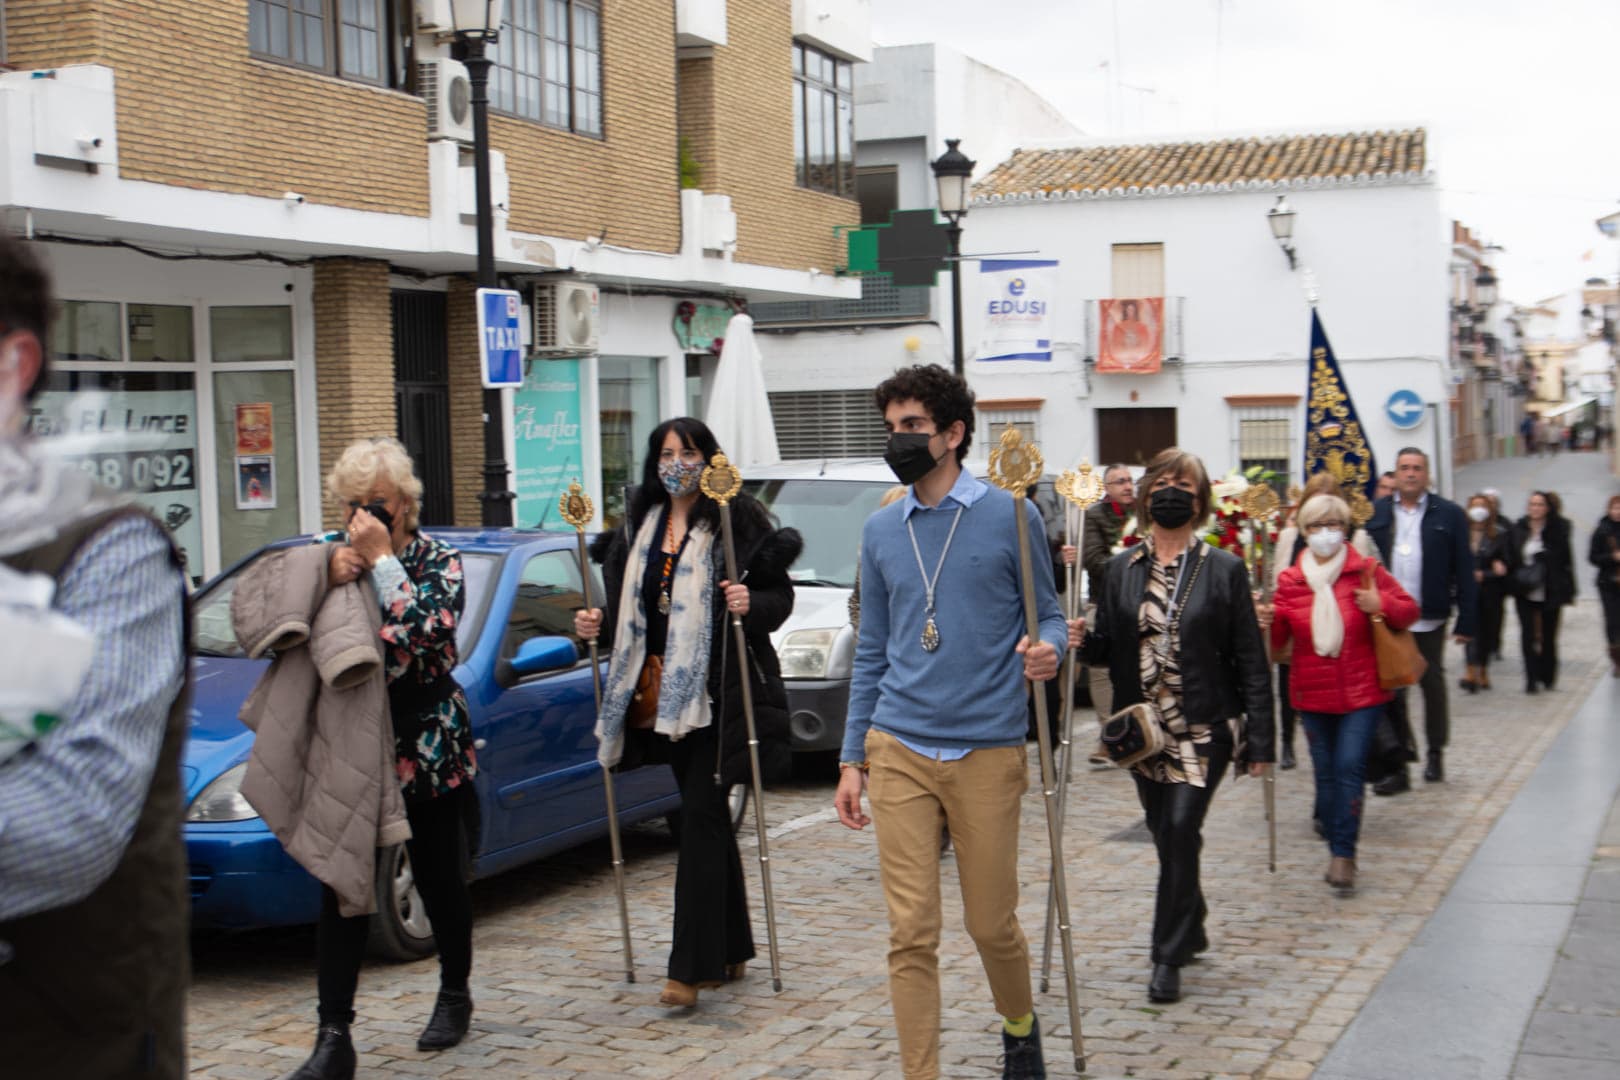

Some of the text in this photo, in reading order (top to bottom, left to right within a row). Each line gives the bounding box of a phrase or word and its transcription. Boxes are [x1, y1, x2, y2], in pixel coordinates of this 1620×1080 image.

[989, 300, 1047, 315] EDUSI
[485, 327, 520, 350] TAXI
[132, 455, 191, 488] 092
